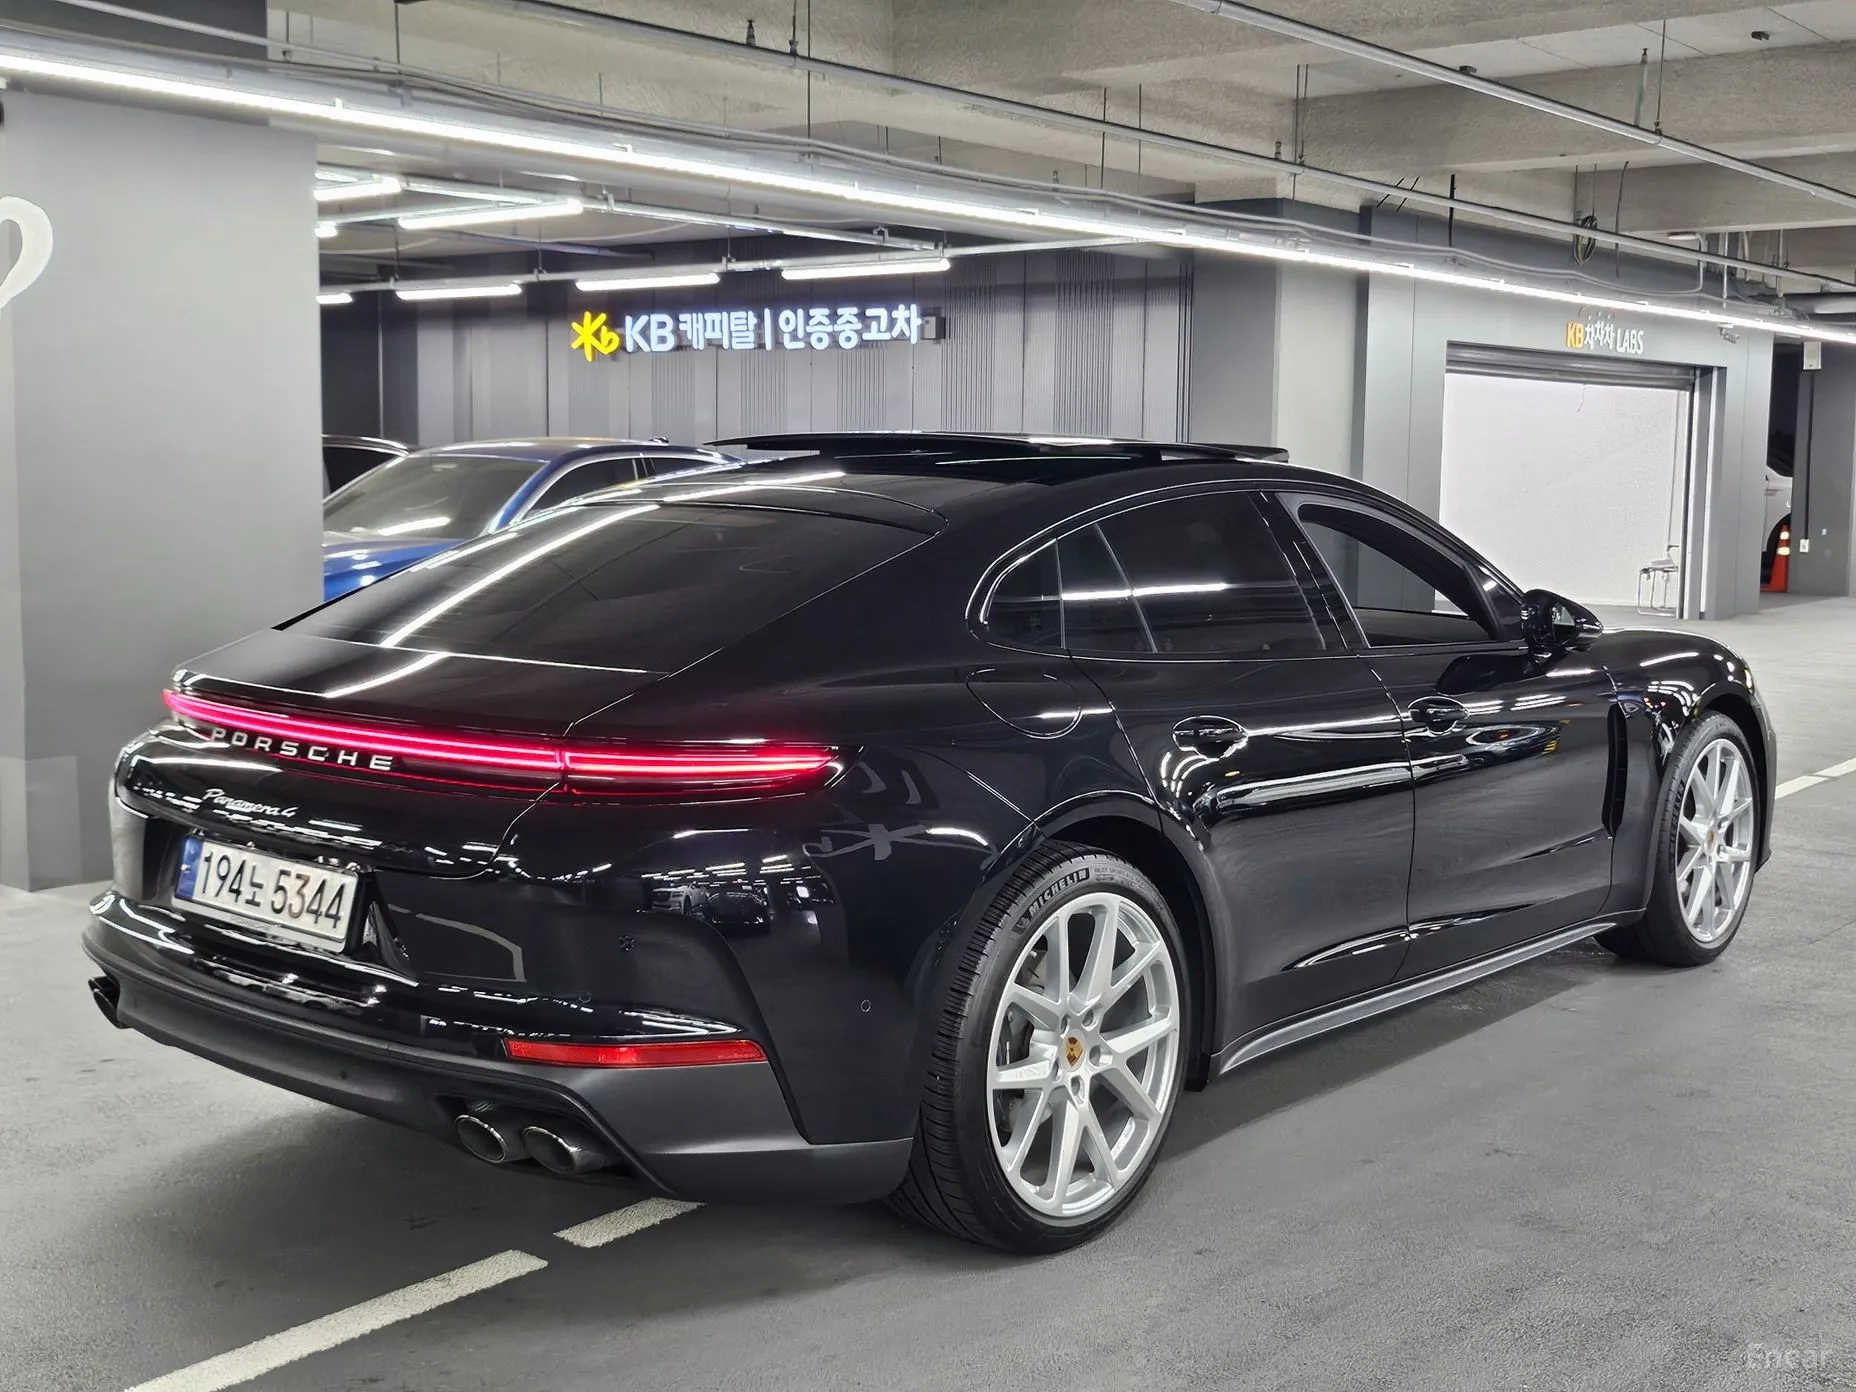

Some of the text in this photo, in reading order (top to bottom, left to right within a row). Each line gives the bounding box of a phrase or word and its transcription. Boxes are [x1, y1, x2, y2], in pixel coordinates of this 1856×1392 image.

[778, 304, 923, 350] 인증중고차
[1616, 328, 1644, 355] LABS
[210, 729, 394, 771] PORSCHE
[1029, 868, 1088, 917] MICHELIN
